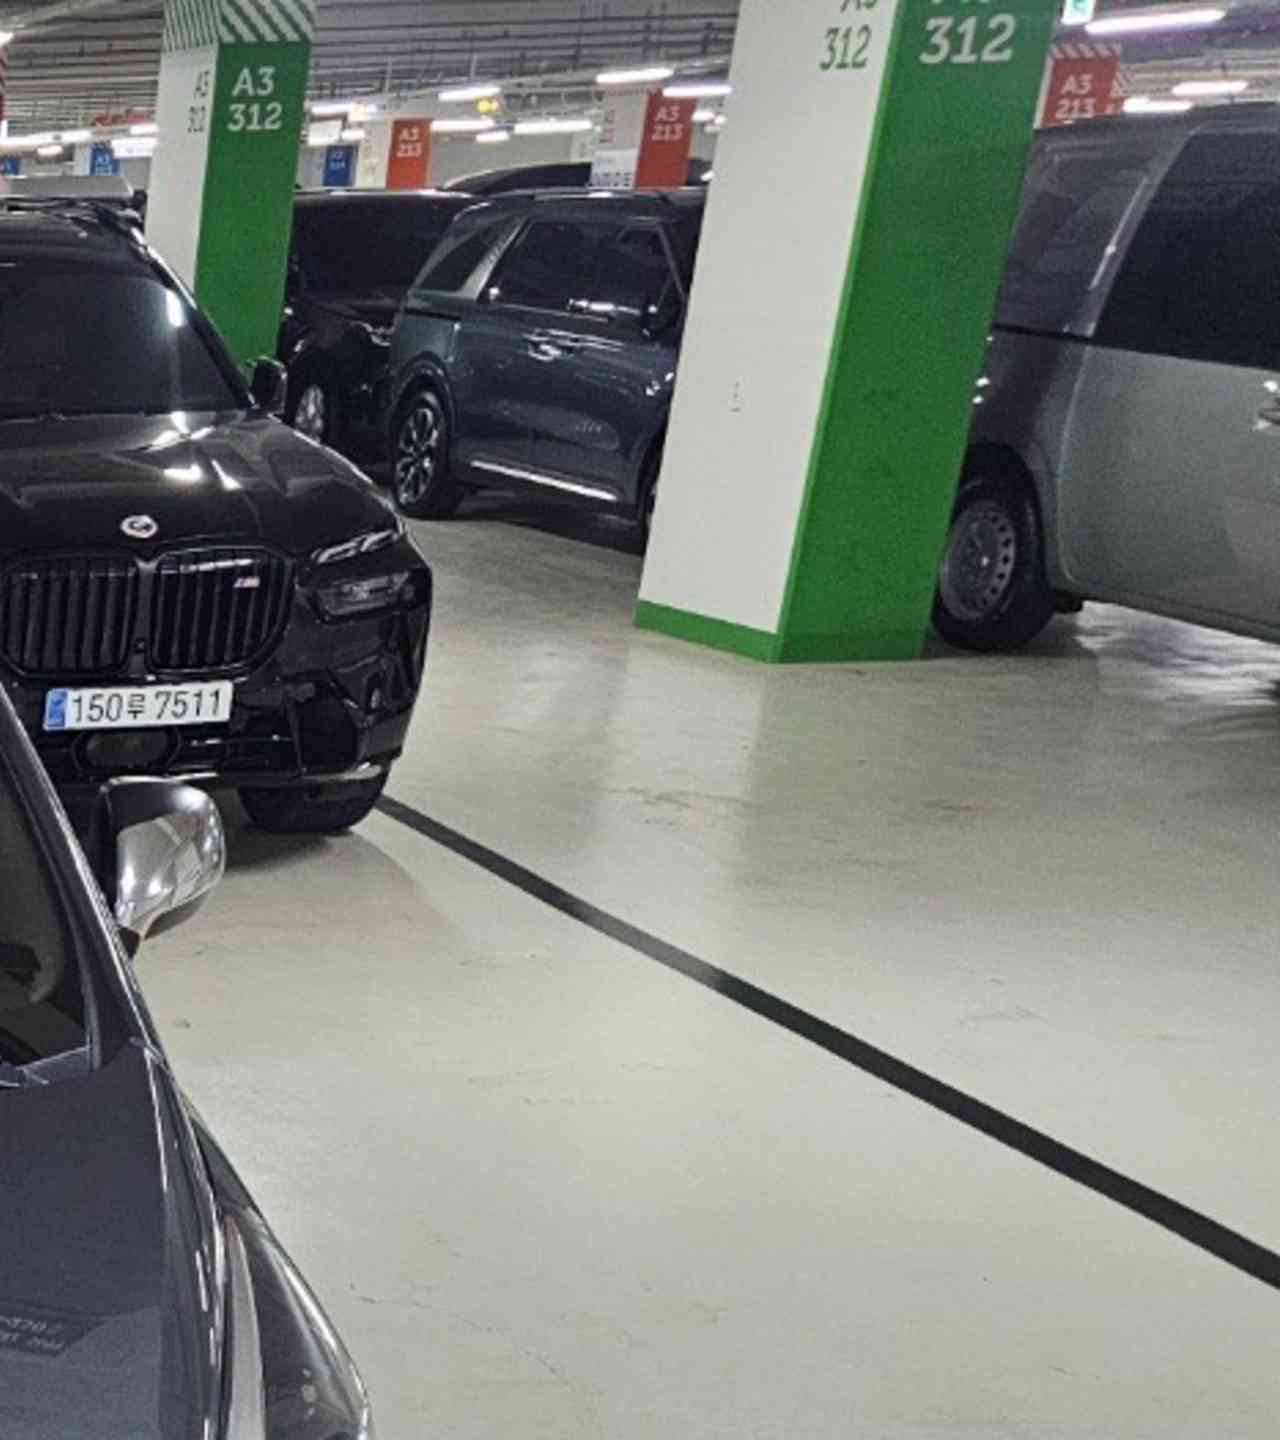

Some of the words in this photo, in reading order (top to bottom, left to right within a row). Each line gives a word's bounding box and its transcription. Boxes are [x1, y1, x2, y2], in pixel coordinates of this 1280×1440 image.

[819, 24, 873, 70] 312
[919, 14, 1016, 64] 312
[231, 66, 276, 97] A3
[1061, 74, 1092, 94] A3
[227, 103, 282, 131] 312
[655, 105, 681, 121] A3
[1055, 98, 1097, 118] 213
